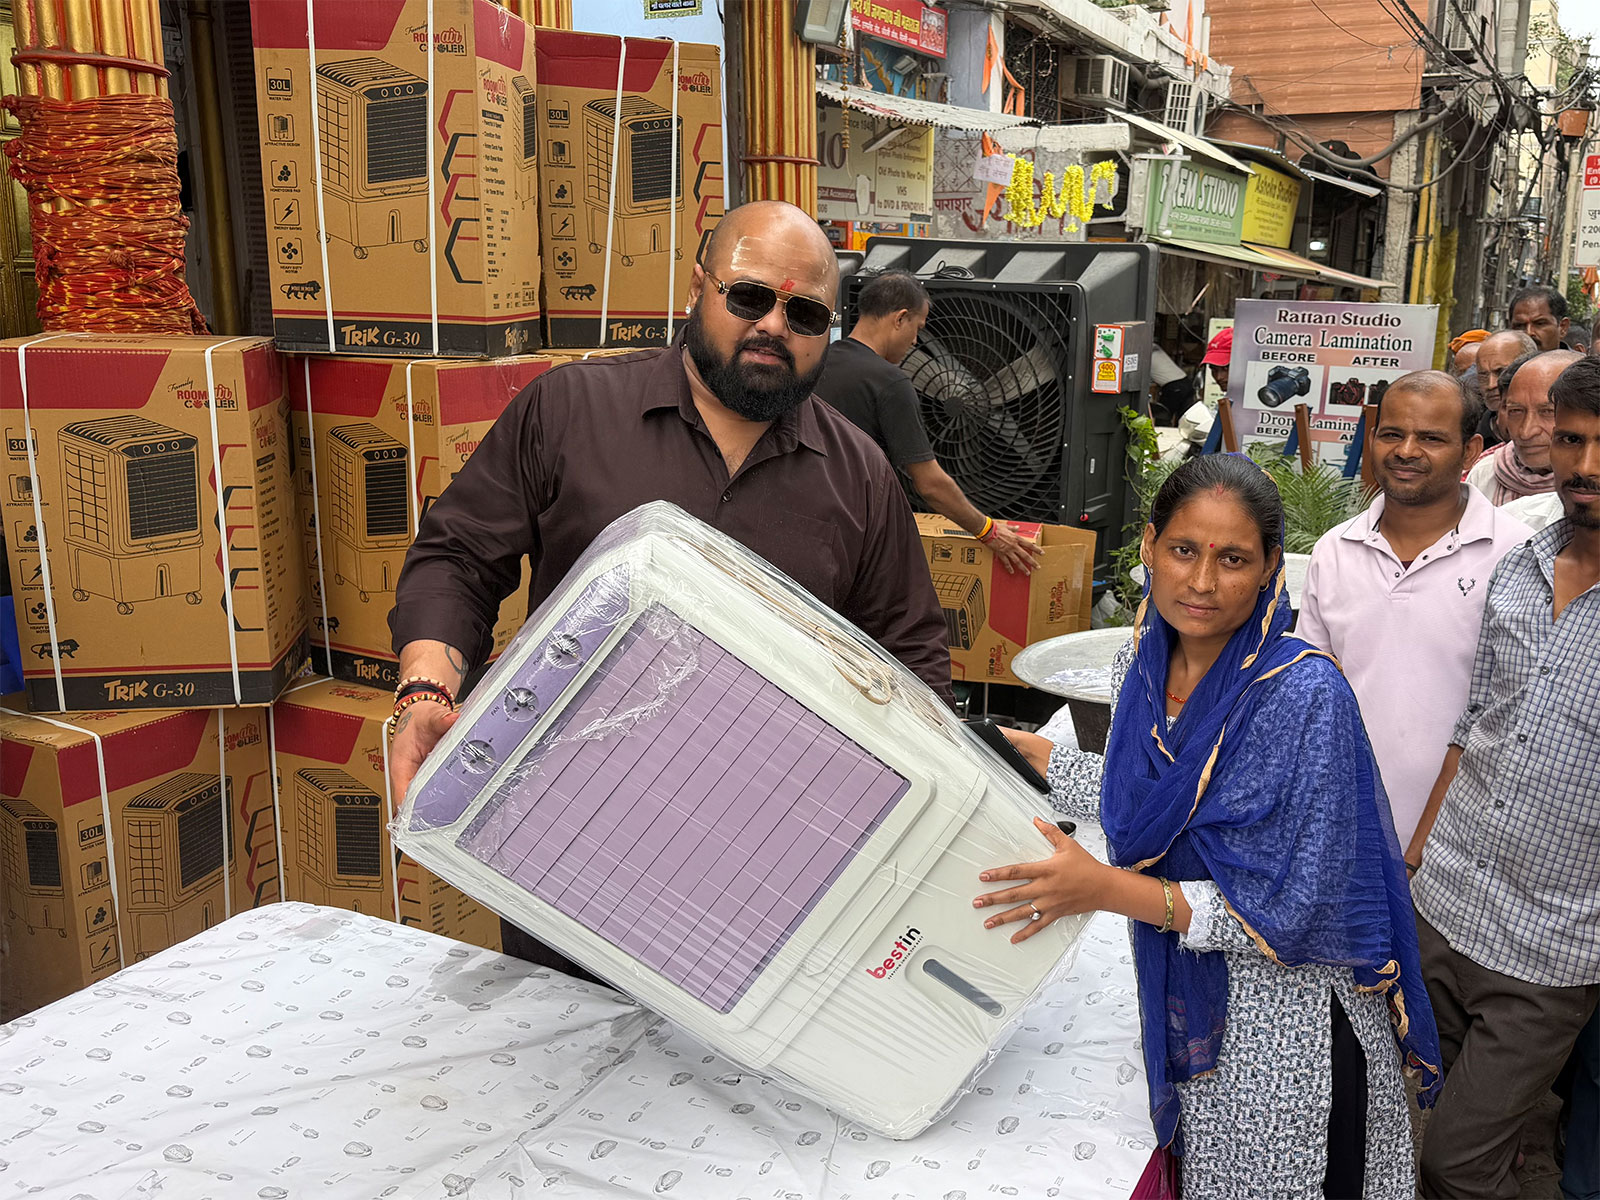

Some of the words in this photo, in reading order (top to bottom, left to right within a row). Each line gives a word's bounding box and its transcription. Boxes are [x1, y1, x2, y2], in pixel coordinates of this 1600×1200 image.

[270, 80, 289, 90] 30L
[550, 110, 567, 119] 30L
[878, 167, 887, 176] Old
[888, 168, 900, 177] Photo
[906, 169, 916, 178] New
[897, 186, 907, 196] VHS
[1197, 173, 1239, 218] STUDIO
[883, 200, 895, 209] DVD
[900, 201, 925, 212] PENDRIVE
[1582, 240, 1600, 249] Pen
[1277, 309, 1336, 325] Rattan
[1341, 312, 1402, 328] Studio
[383, 330, 420, 346] G-30
[645, 327, 675, 339] G-3
[1254, 327, 1312, 347] Camera
[1319, 330, 1412, 351] Lamination
[1261, 352, 1316, 363] BEFORE
[1352, 356, 1400, 367] AFTER
[167, 377, 193, 393] Family
[177, 390, 208, 400] ROOM
[1259, 412, 1294, 426] Dron
[1309, 414, 1359, 432] Lamina
[1256, 426, 1291, 437] BEFO
[11, 440, 26, 450] 30
[153, 682, 195, 698] G-30
[491, 706, 500, 716] FAN
[82, 827, 102, 840] 30L
[866, 926, 921, 979] bestin
